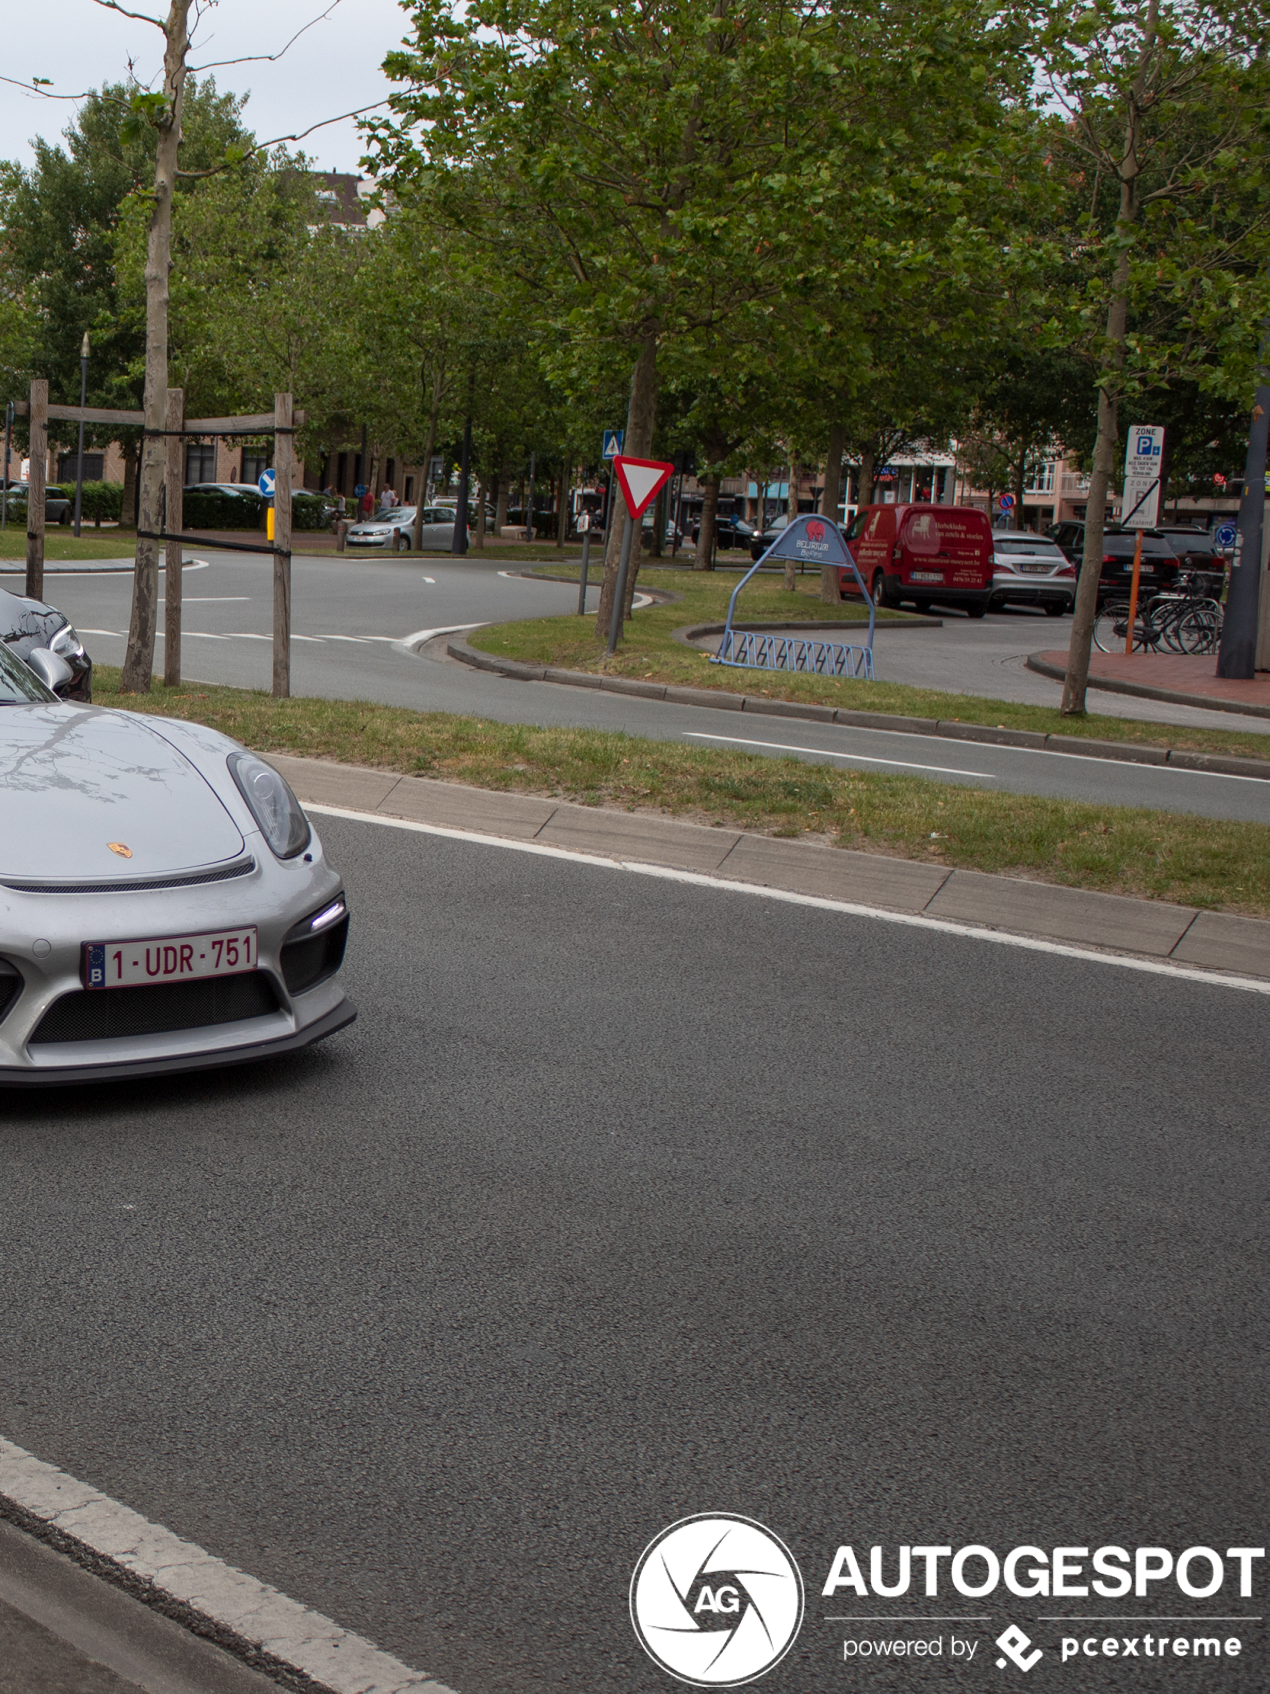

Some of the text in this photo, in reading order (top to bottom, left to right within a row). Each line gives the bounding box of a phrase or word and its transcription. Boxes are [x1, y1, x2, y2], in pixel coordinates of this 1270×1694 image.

[1135, 428, 1156, 436] ZONE
[112, 935, 251, 979] 1-UDR-751
[91, 968, 103, 982] B
